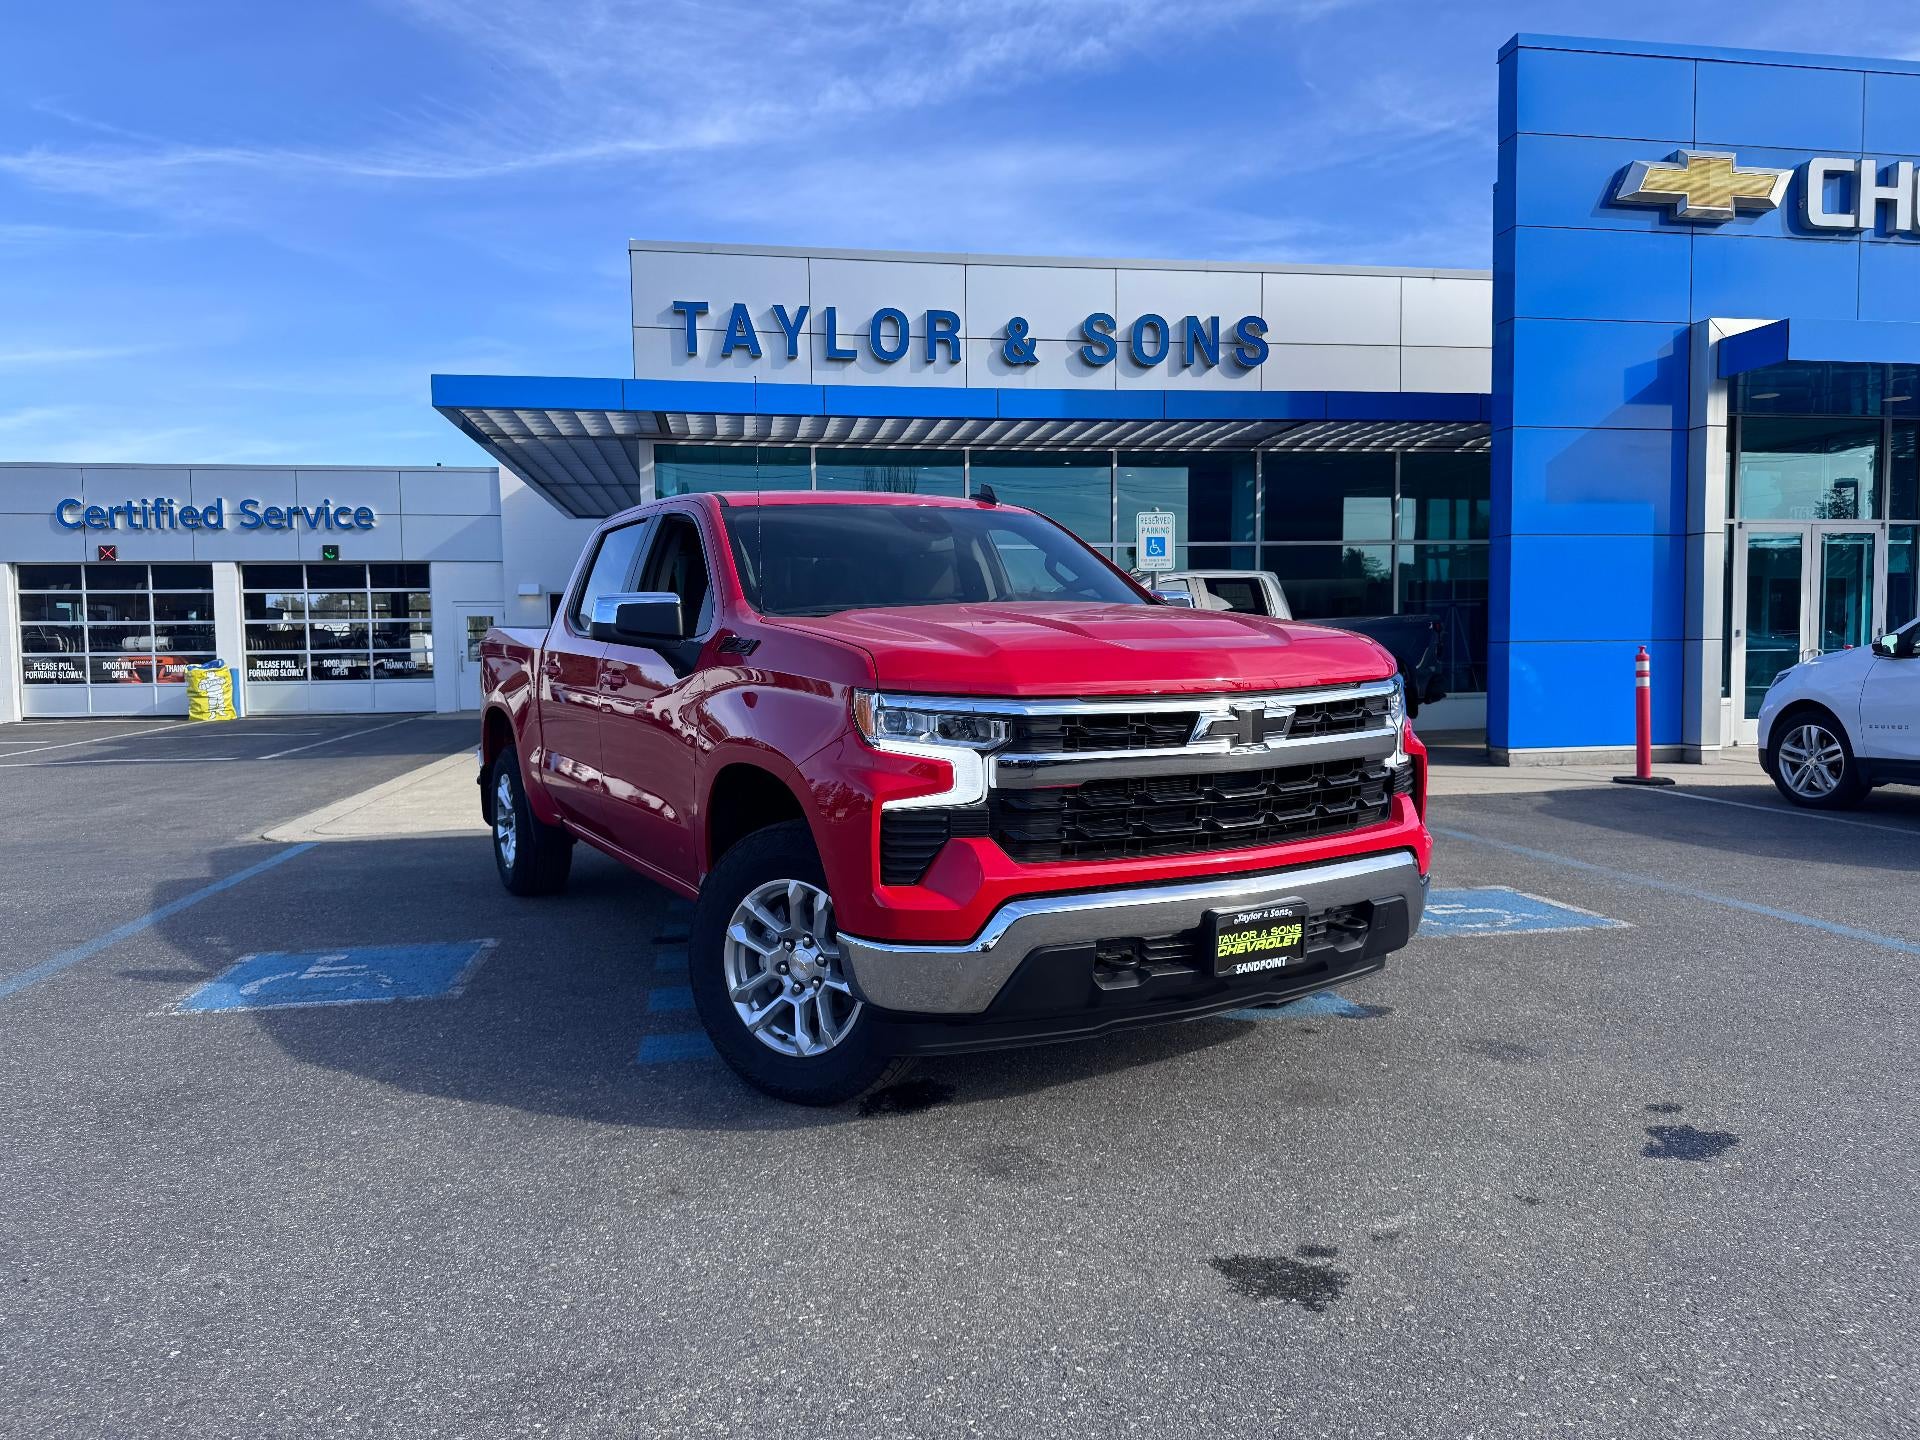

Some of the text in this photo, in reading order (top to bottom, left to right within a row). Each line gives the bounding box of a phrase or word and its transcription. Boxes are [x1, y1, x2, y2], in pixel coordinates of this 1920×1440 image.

[1808, 157, 1920, 230] CH
[673, 301, 1269, 367] TAYLOR & SONS
[56, 497, 375, 529] Certified Service
[1140, 516, 1171, 525] RESERVED
[1141, 527, 1170, 535] PARKING
[33, 662, 75, 671] PLEASE PULL
[102, 661, 137, 670] DOOR WILL
[256, 660, 296, 669] PLEASE PULL
[323, 659, 340, 668] DOOR
[384, 661, 404, 670] THANK
[25, 670, 83, 679] FORWARD SLOWLY
[111, 670, 129, 679] OPEN
[248, 668, 304, 677] FORWARD SLOWLY
[331, 668, 349, 676] OPEN
[1238, 912, 1263, 924] Taylor
[1270, 908, 1289, 918] Sons
[1218, 923, 1302, 945] TAYLOR & SONS
[1217, 934, 1303, 957] CHEVROLET
[1235, 956, 1288, 975] SANDPOINT
